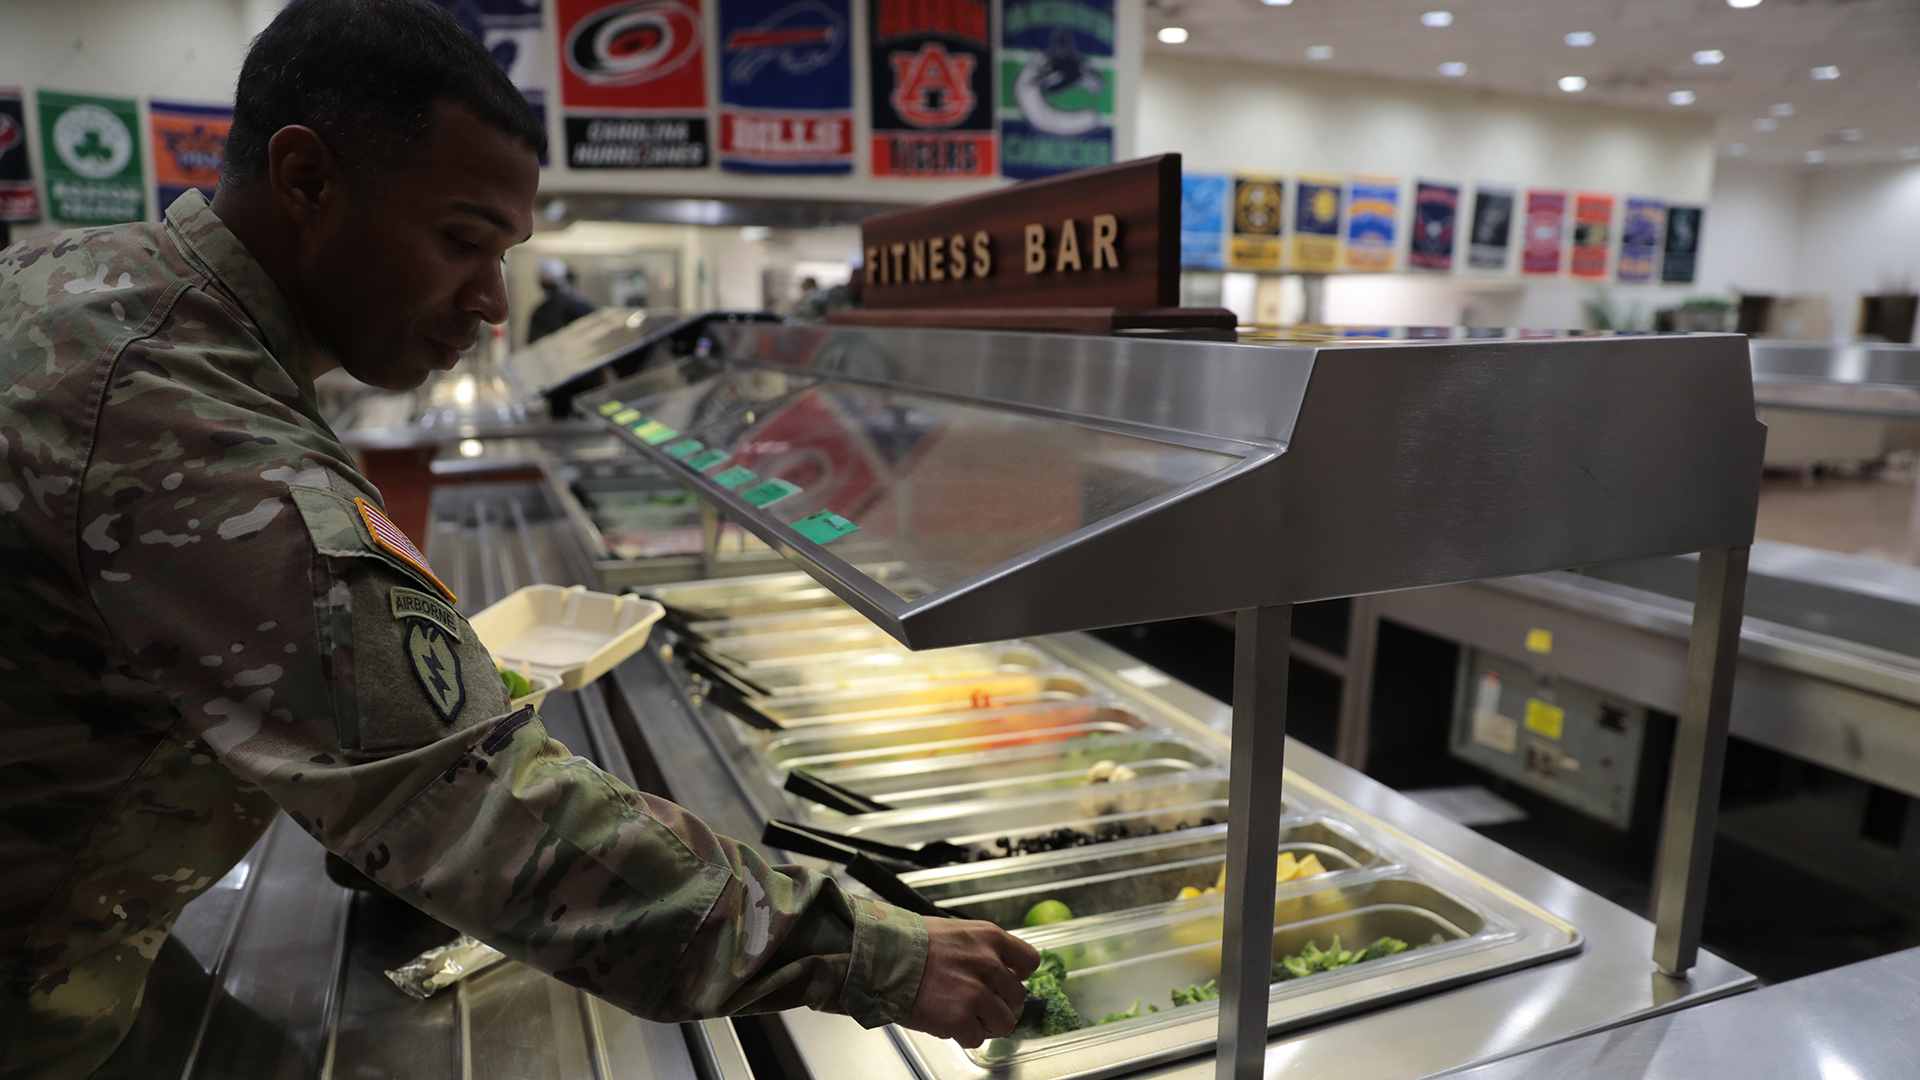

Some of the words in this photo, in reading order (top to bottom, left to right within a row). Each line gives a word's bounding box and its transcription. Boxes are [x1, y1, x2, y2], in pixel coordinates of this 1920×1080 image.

[587, 120, 689, 142] CAROLINA
[730, 118, 843, 152] BILLS
[890, 138, 977, 171] TIGERS
[865, 230, 993, 284] FITNESS
[1023, 213, 1120, 274] BAR
[395, 594, 457, 631] AIRBORNE
